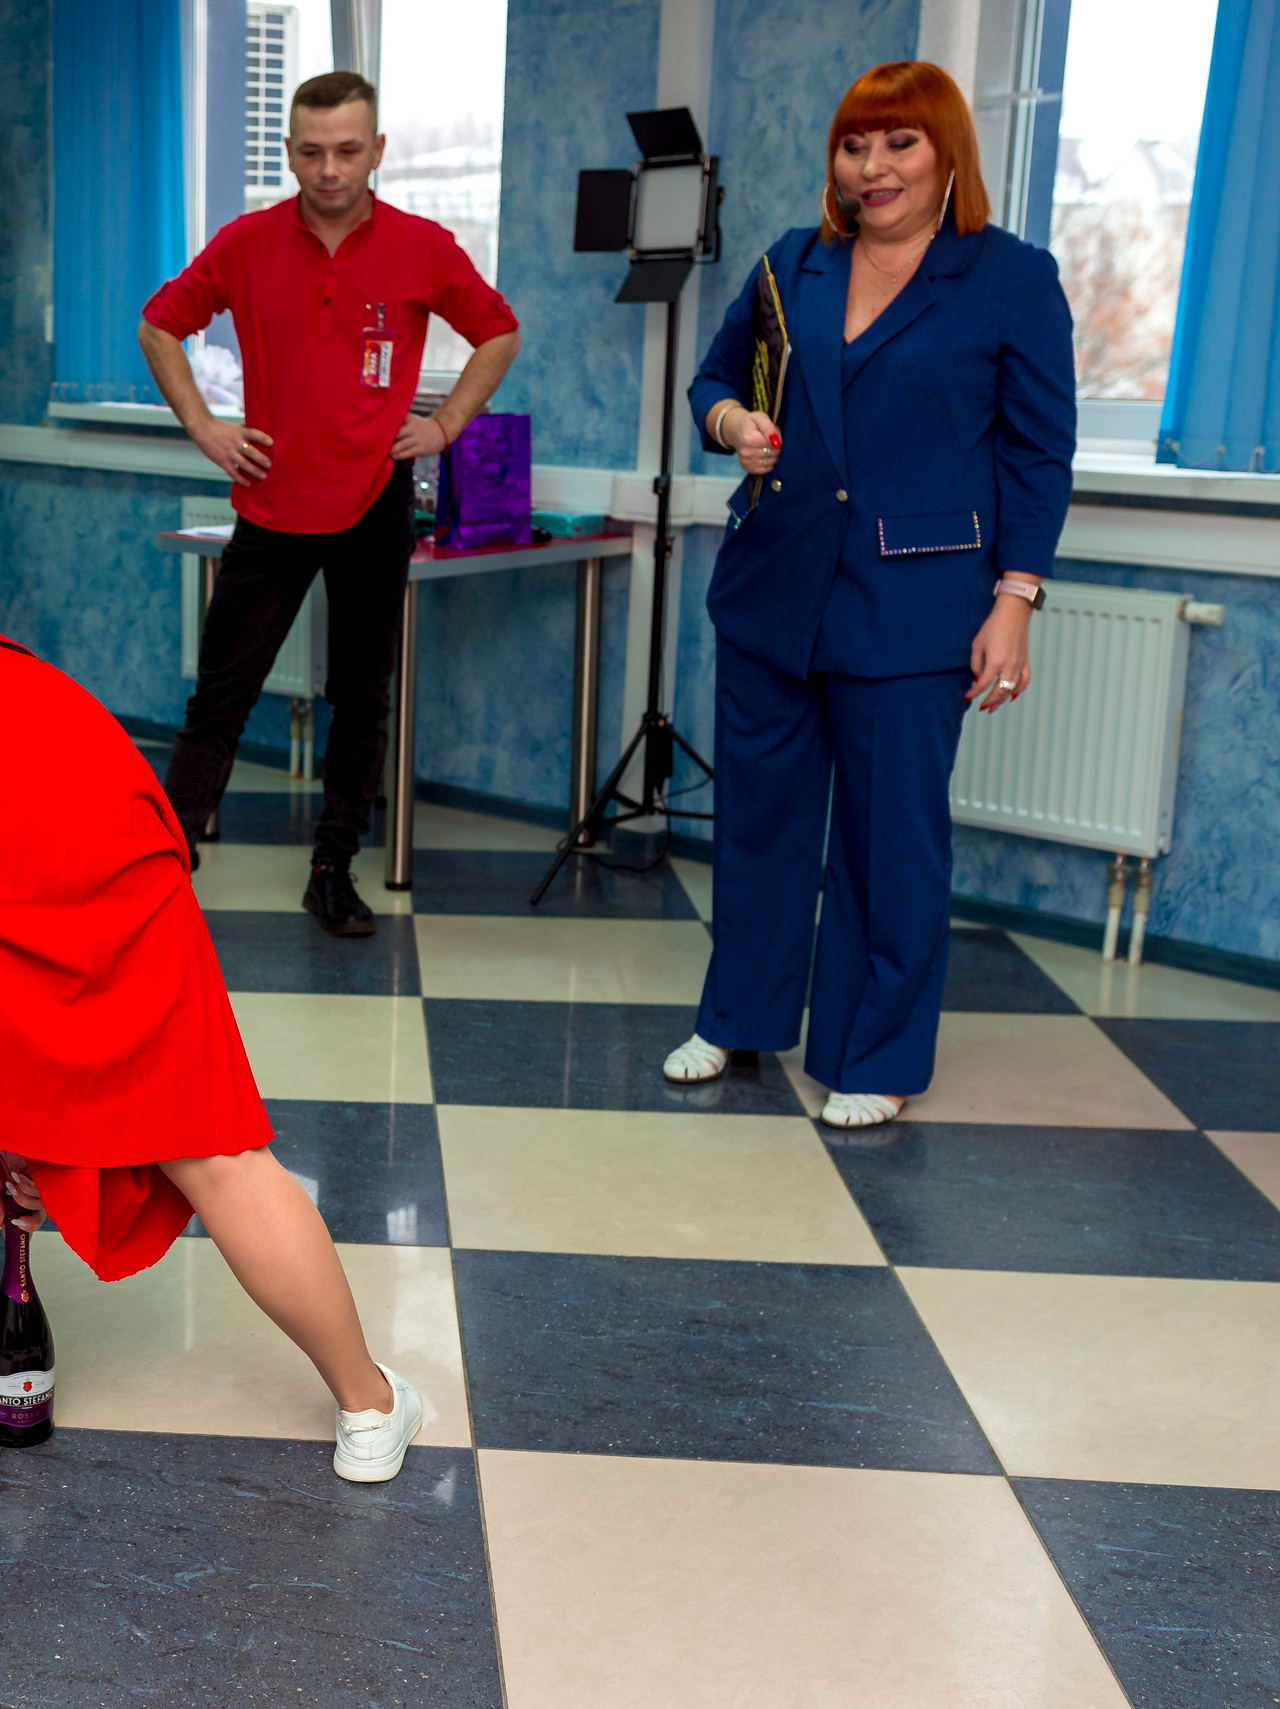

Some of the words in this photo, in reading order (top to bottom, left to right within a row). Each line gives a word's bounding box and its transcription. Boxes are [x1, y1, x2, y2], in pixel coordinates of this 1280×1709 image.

[19, 1233, 27, 1263] STEFANO
[19, 1264, 27, 1287] SANTO
[11, 1411, 41, 1420] ROSSO
